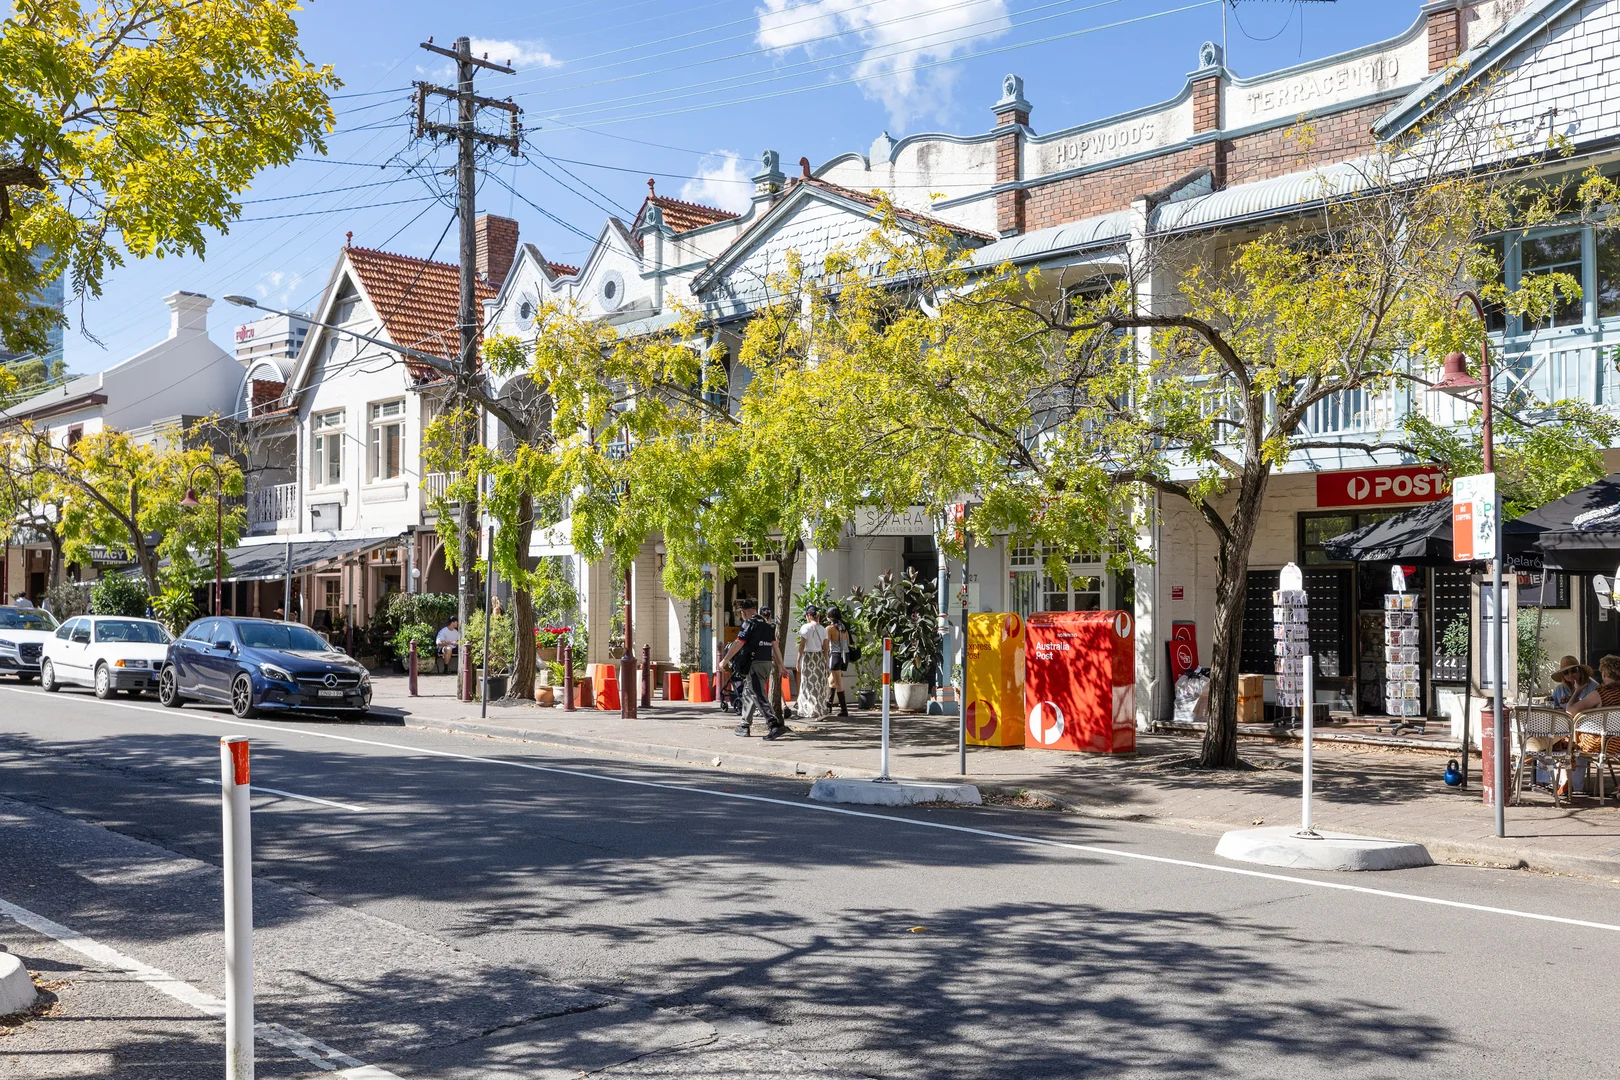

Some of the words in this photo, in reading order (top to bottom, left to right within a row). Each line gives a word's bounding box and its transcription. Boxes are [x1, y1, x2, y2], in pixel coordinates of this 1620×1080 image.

[1247, 67, 1349, 114] TERRACE
[1350, 57, 1399, 88] 1910
[1055, 122, 1155, 164] HOPWOOD'S
[1375, 473, 1444, 498] POST
[966, 643, 992, 651] xpress
[1035, 641, 1070, 651] Australia
[1035, 651, 1054, 660] Post
